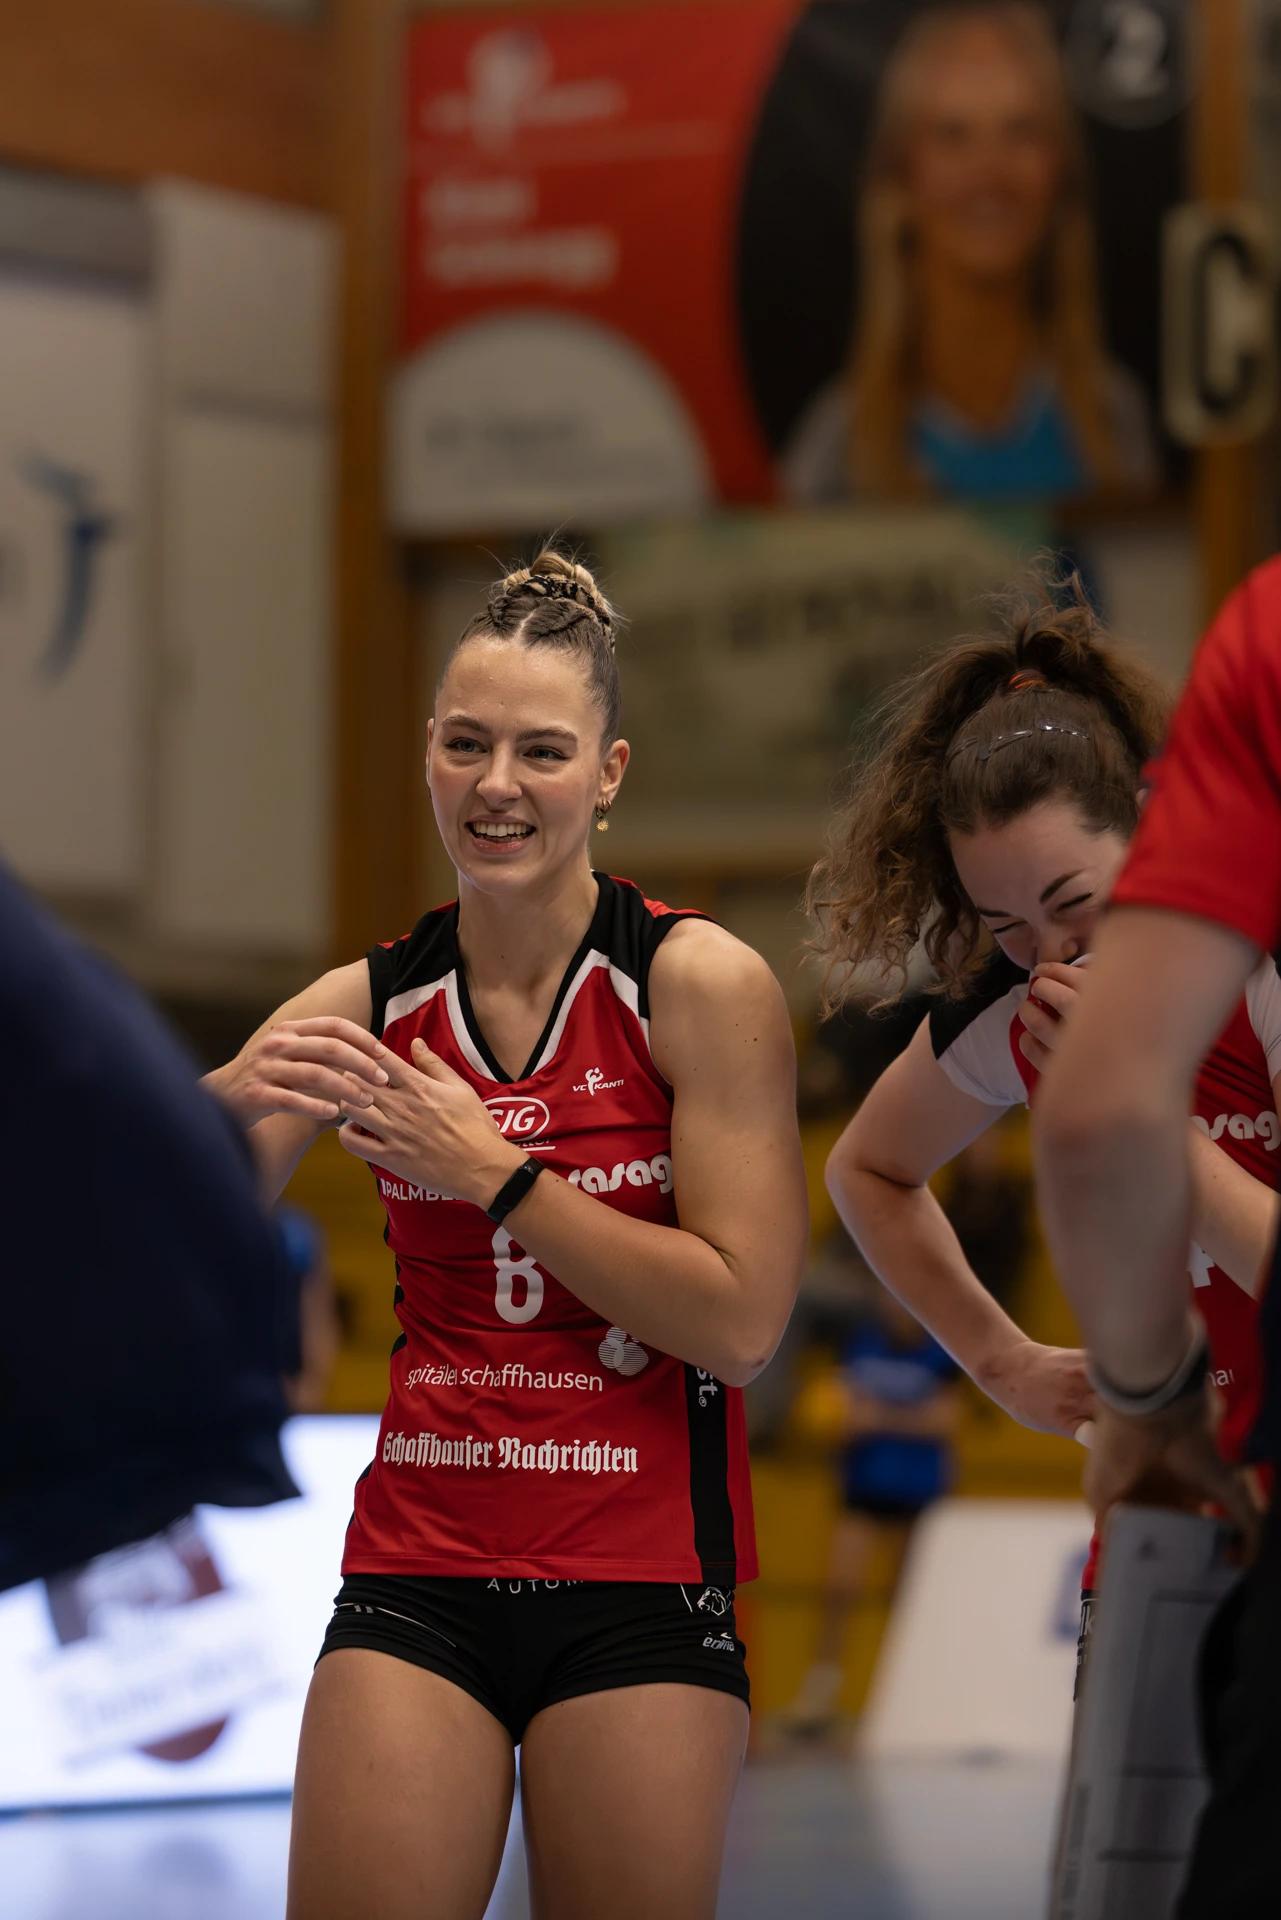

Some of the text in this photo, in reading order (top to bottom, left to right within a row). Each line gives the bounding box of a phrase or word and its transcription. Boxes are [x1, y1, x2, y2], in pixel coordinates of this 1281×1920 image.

[572, 1078, 625, 1092] VC KANTI
[492, 1226, 544, 1324] 8
[460, 1364, 603, 1392] schaffhausen
[498, 1436, 639, 1475] Nachrichten
